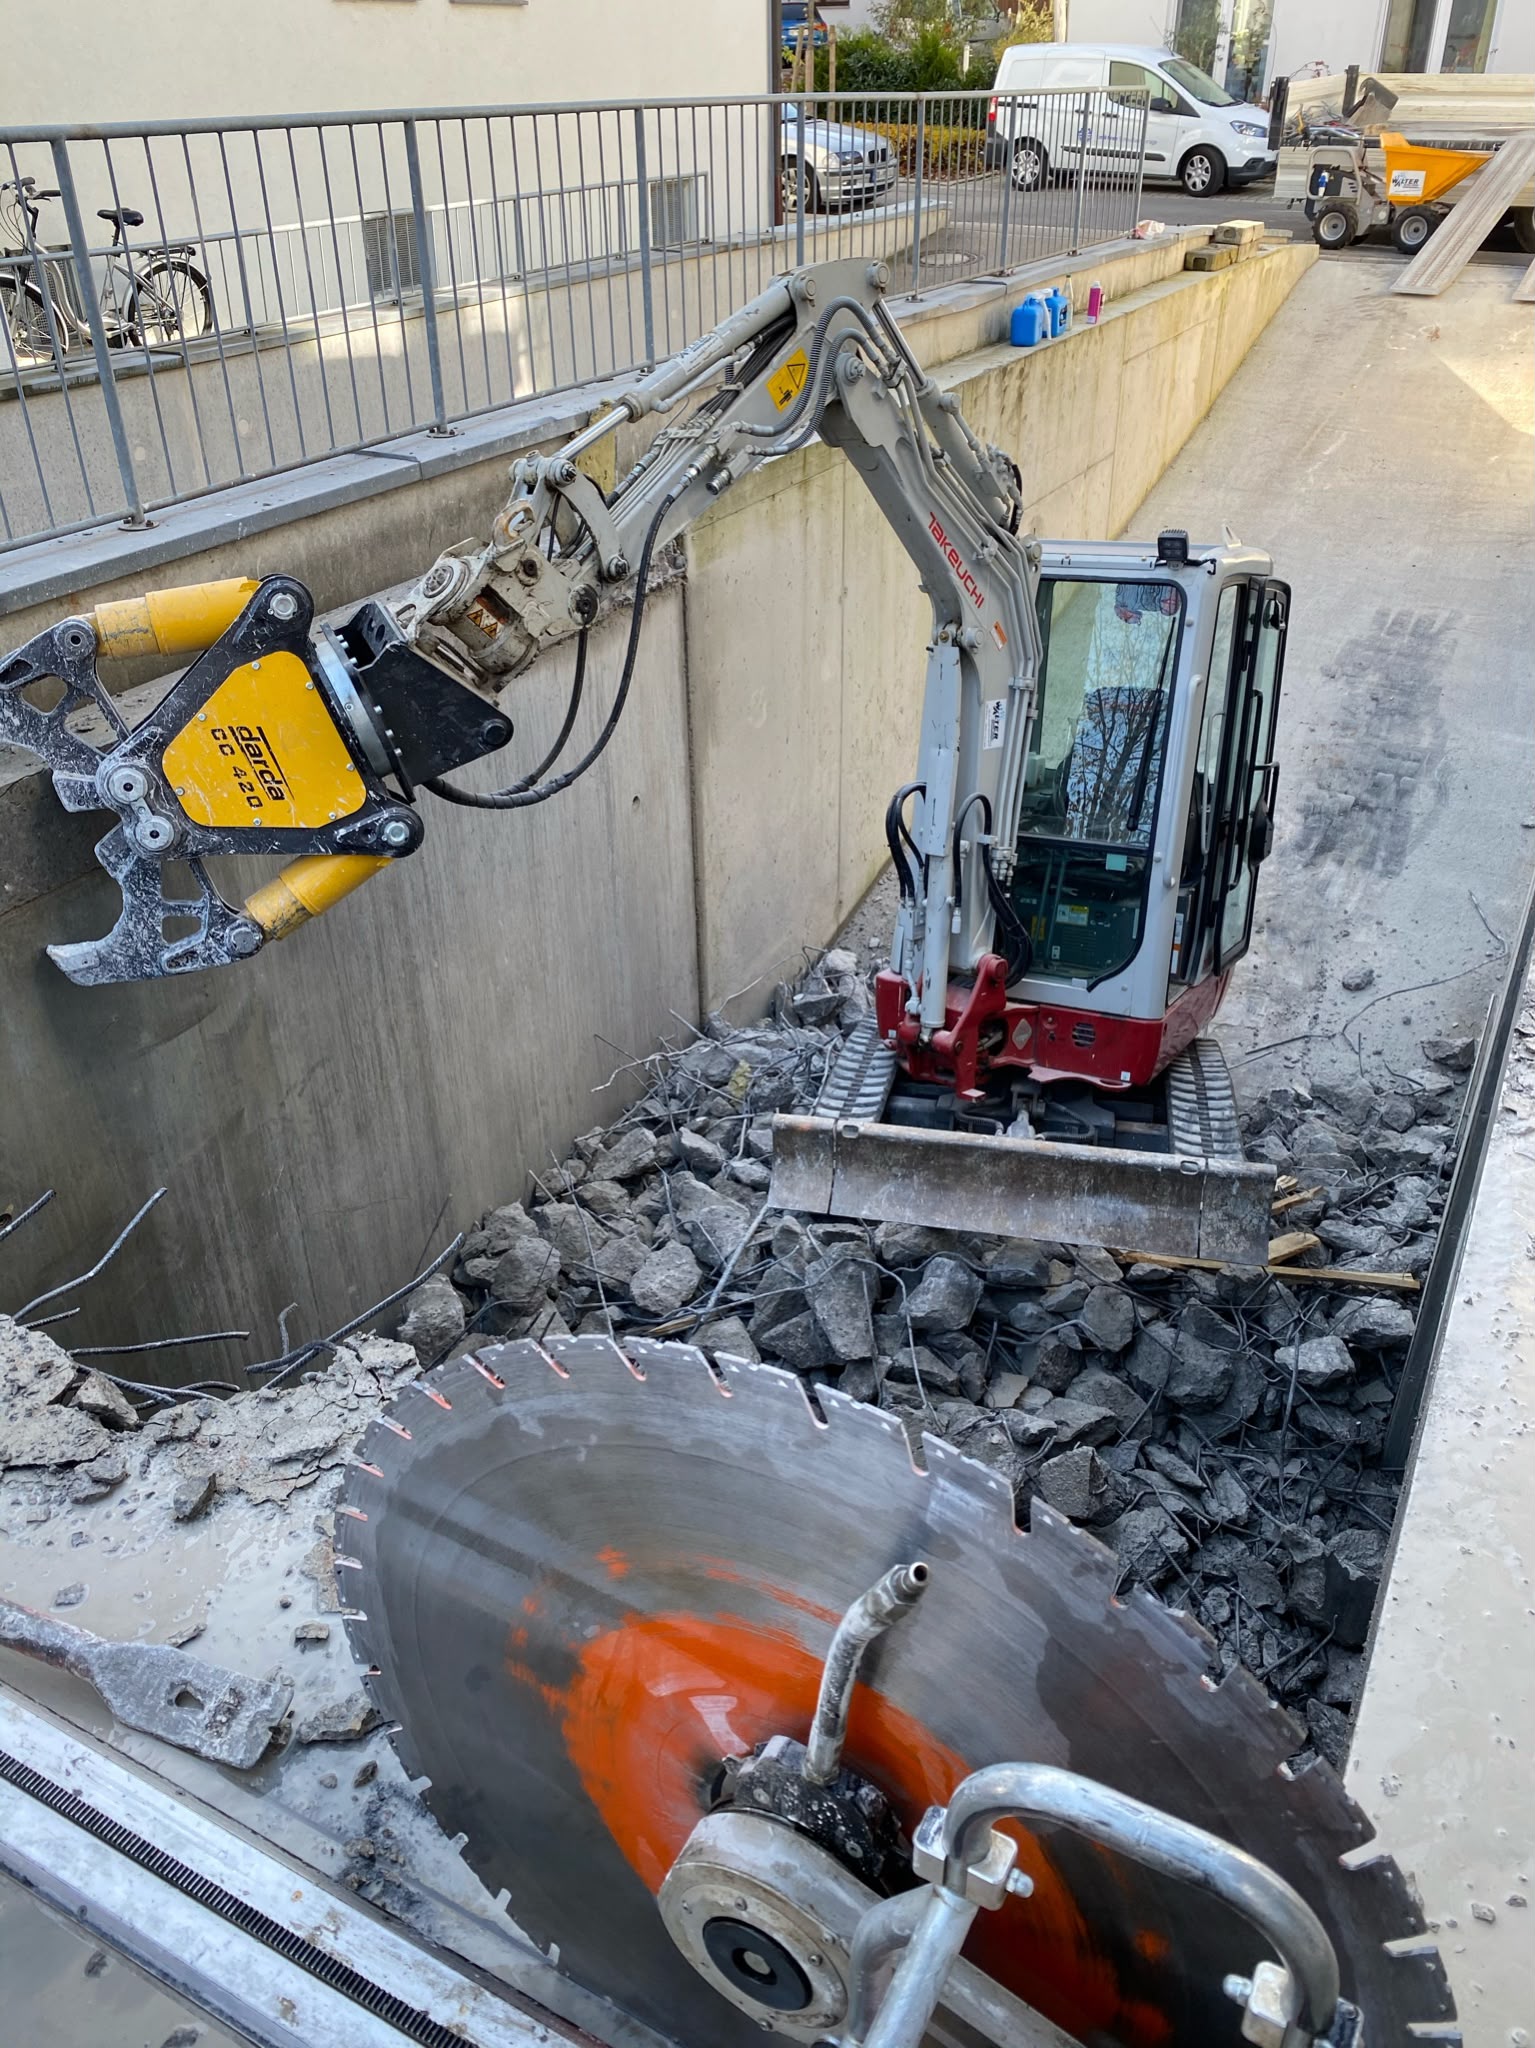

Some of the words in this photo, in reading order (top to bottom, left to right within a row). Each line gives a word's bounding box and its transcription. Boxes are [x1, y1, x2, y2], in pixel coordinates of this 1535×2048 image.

[928, 511, 984, 608] TAKEUCHI
[232, 766, 263, 808] 420
[236, 726, 285, 801] darda
